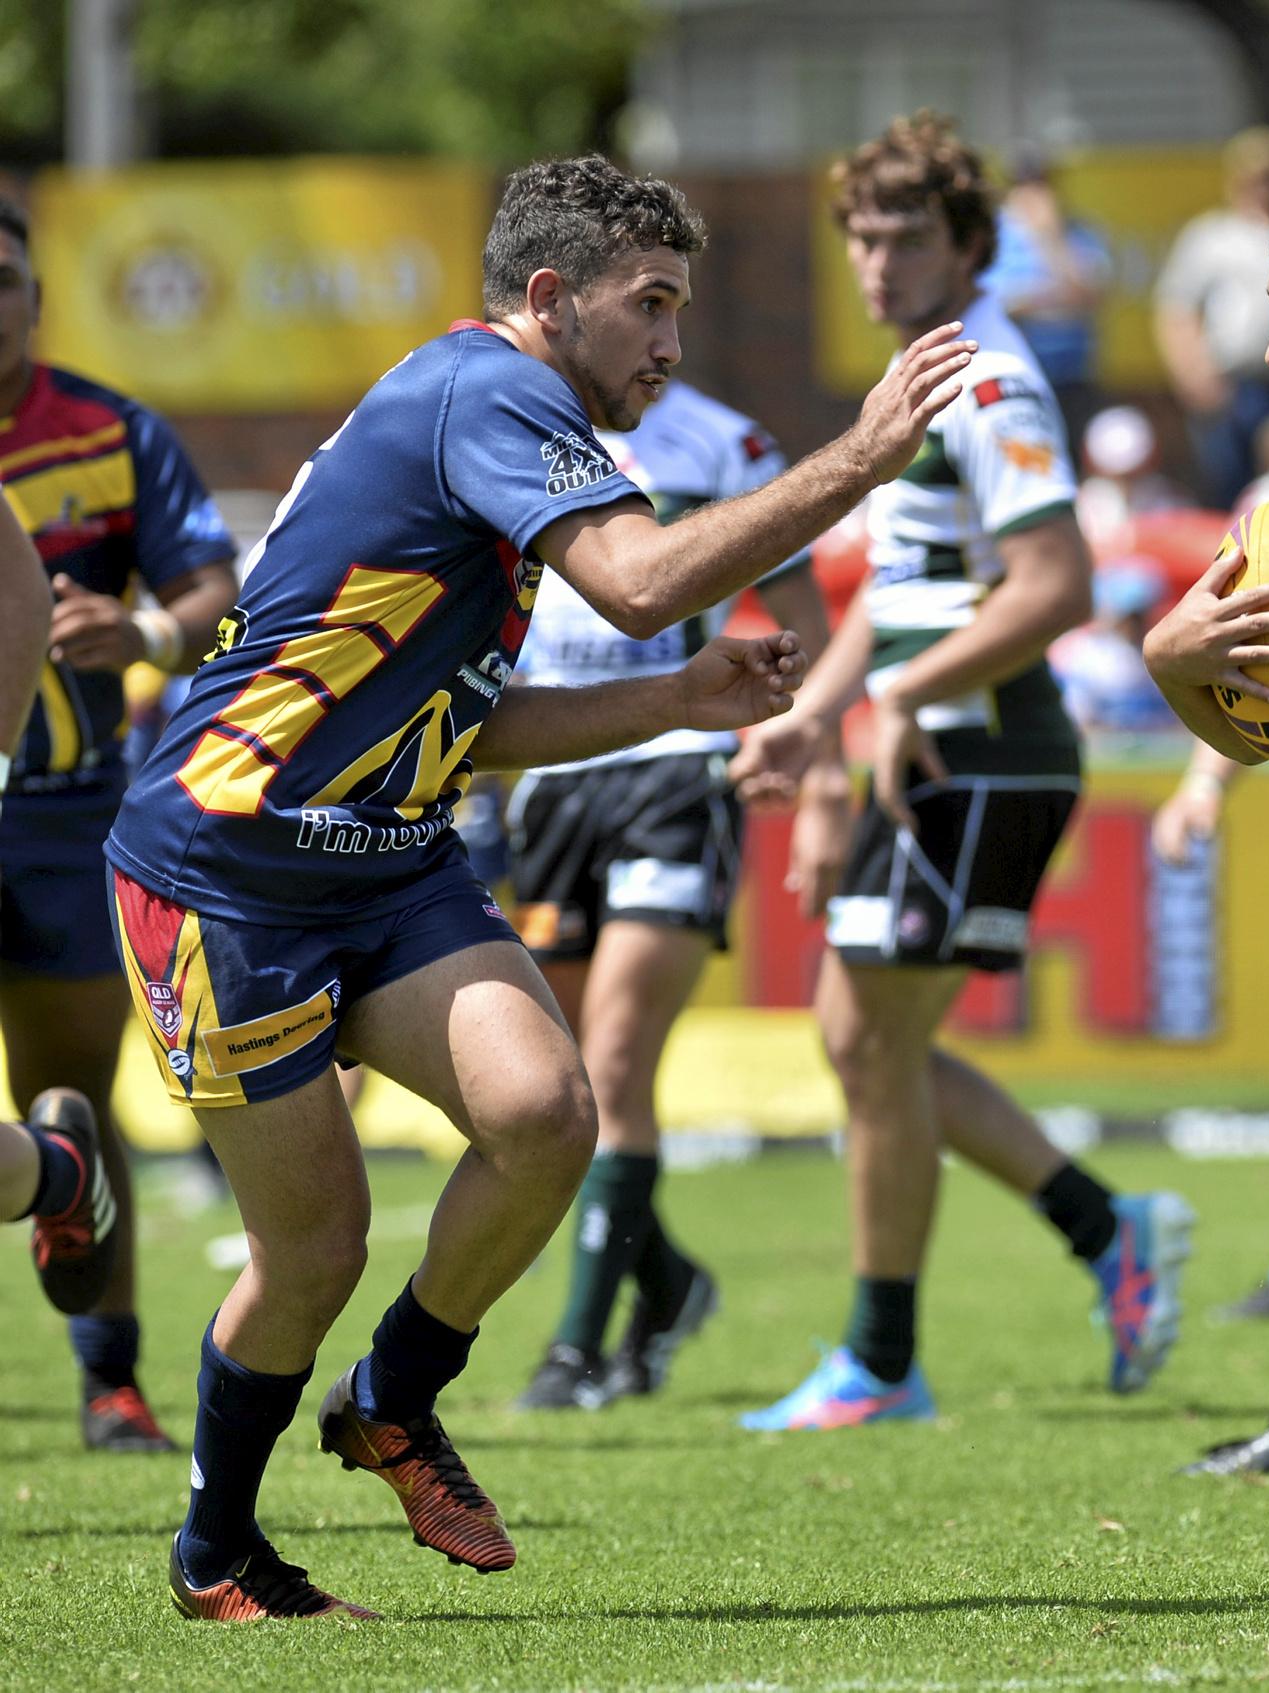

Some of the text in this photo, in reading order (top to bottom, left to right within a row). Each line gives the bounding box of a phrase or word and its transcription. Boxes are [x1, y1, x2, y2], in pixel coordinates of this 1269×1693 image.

[296, 809, 371, 853] i'm
[151, 986, 172, 1000] QLD
[227, 1010, 326, 1056] Hastings Deering
